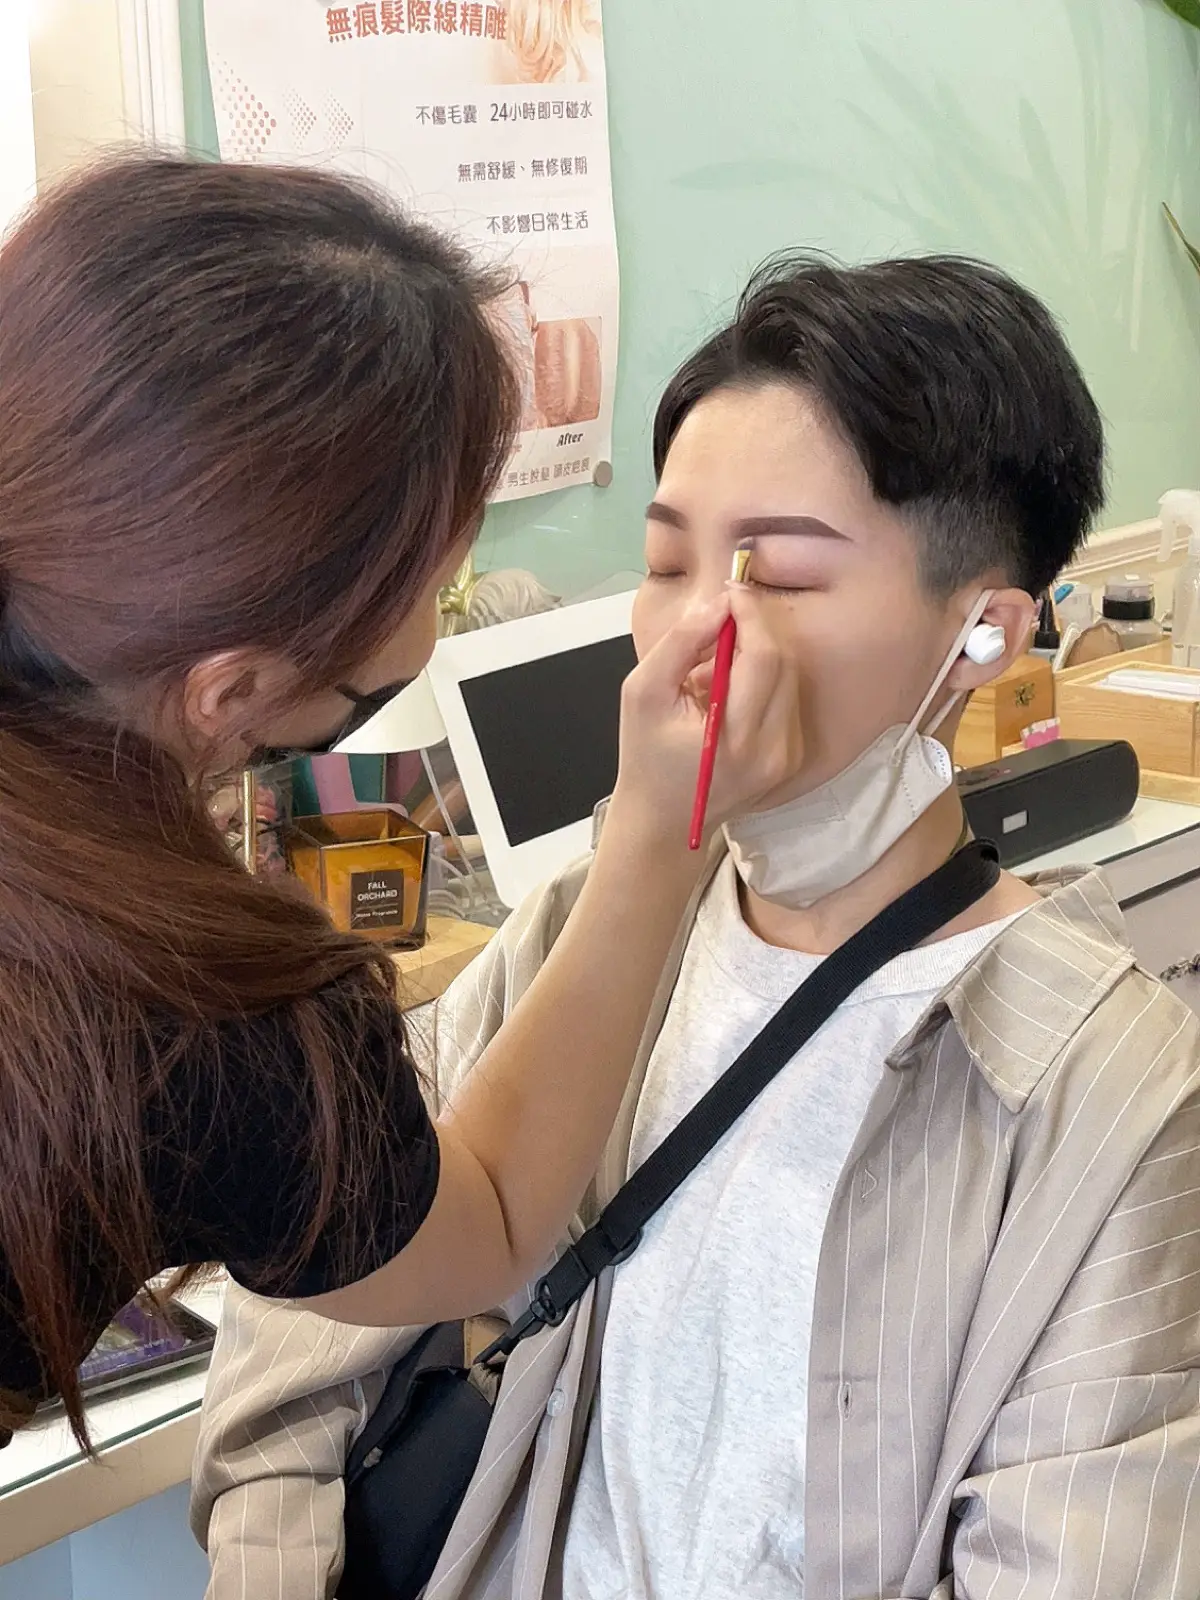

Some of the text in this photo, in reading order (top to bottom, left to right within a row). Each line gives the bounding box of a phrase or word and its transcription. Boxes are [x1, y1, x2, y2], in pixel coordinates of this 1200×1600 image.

[326, 0, 507, 43] 無痕髮際線精雕
[416, 100, 592, 125] 不傷毛囊 24小時即可碰水
[458, 156, 588, 182] 無需舒緩、無修復期
[486, 210, 588, 234] 不影響日常生活
[556, 432, 583, 447] After
[357, 890, 398, 901] ORCHARD
[368, 881, 387, 889] FALL
